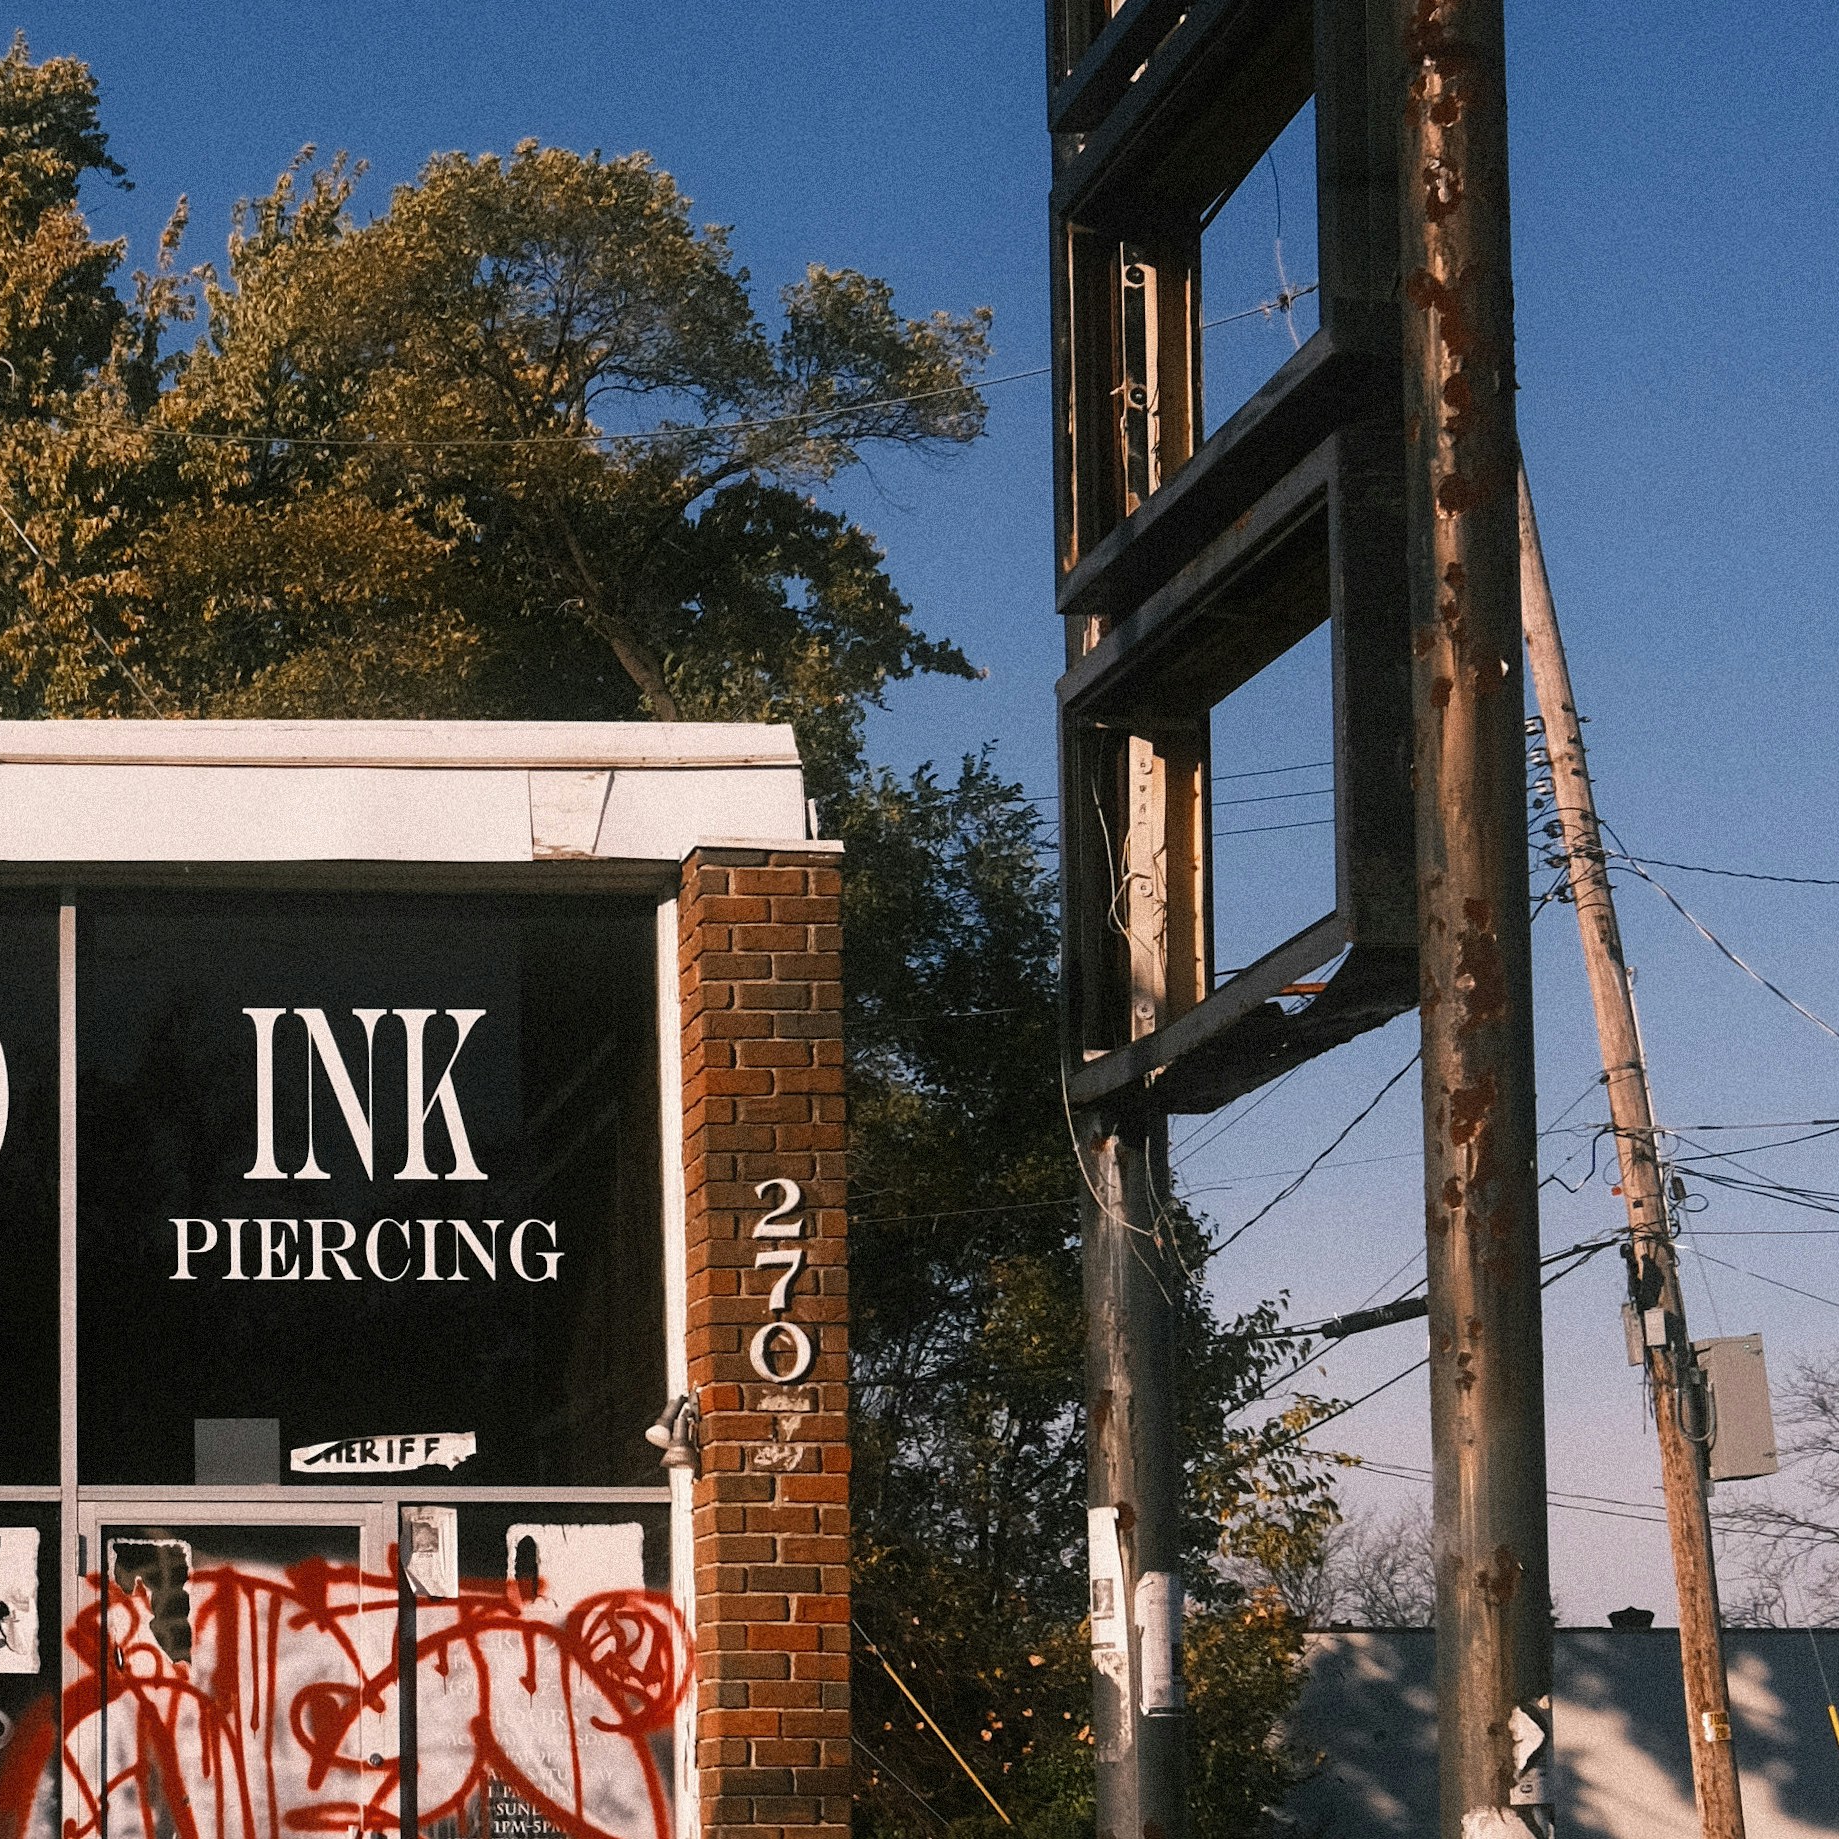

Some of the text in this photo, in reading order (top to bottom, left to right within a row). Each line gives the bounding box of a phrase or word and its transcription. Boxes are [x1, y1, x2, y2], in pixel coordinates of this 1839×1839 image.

[242, 1007, 488, 1182] INK
[168, 1219, 565, 1282] PIERCING
[306, 1437, 440, 1464] HERIFF
